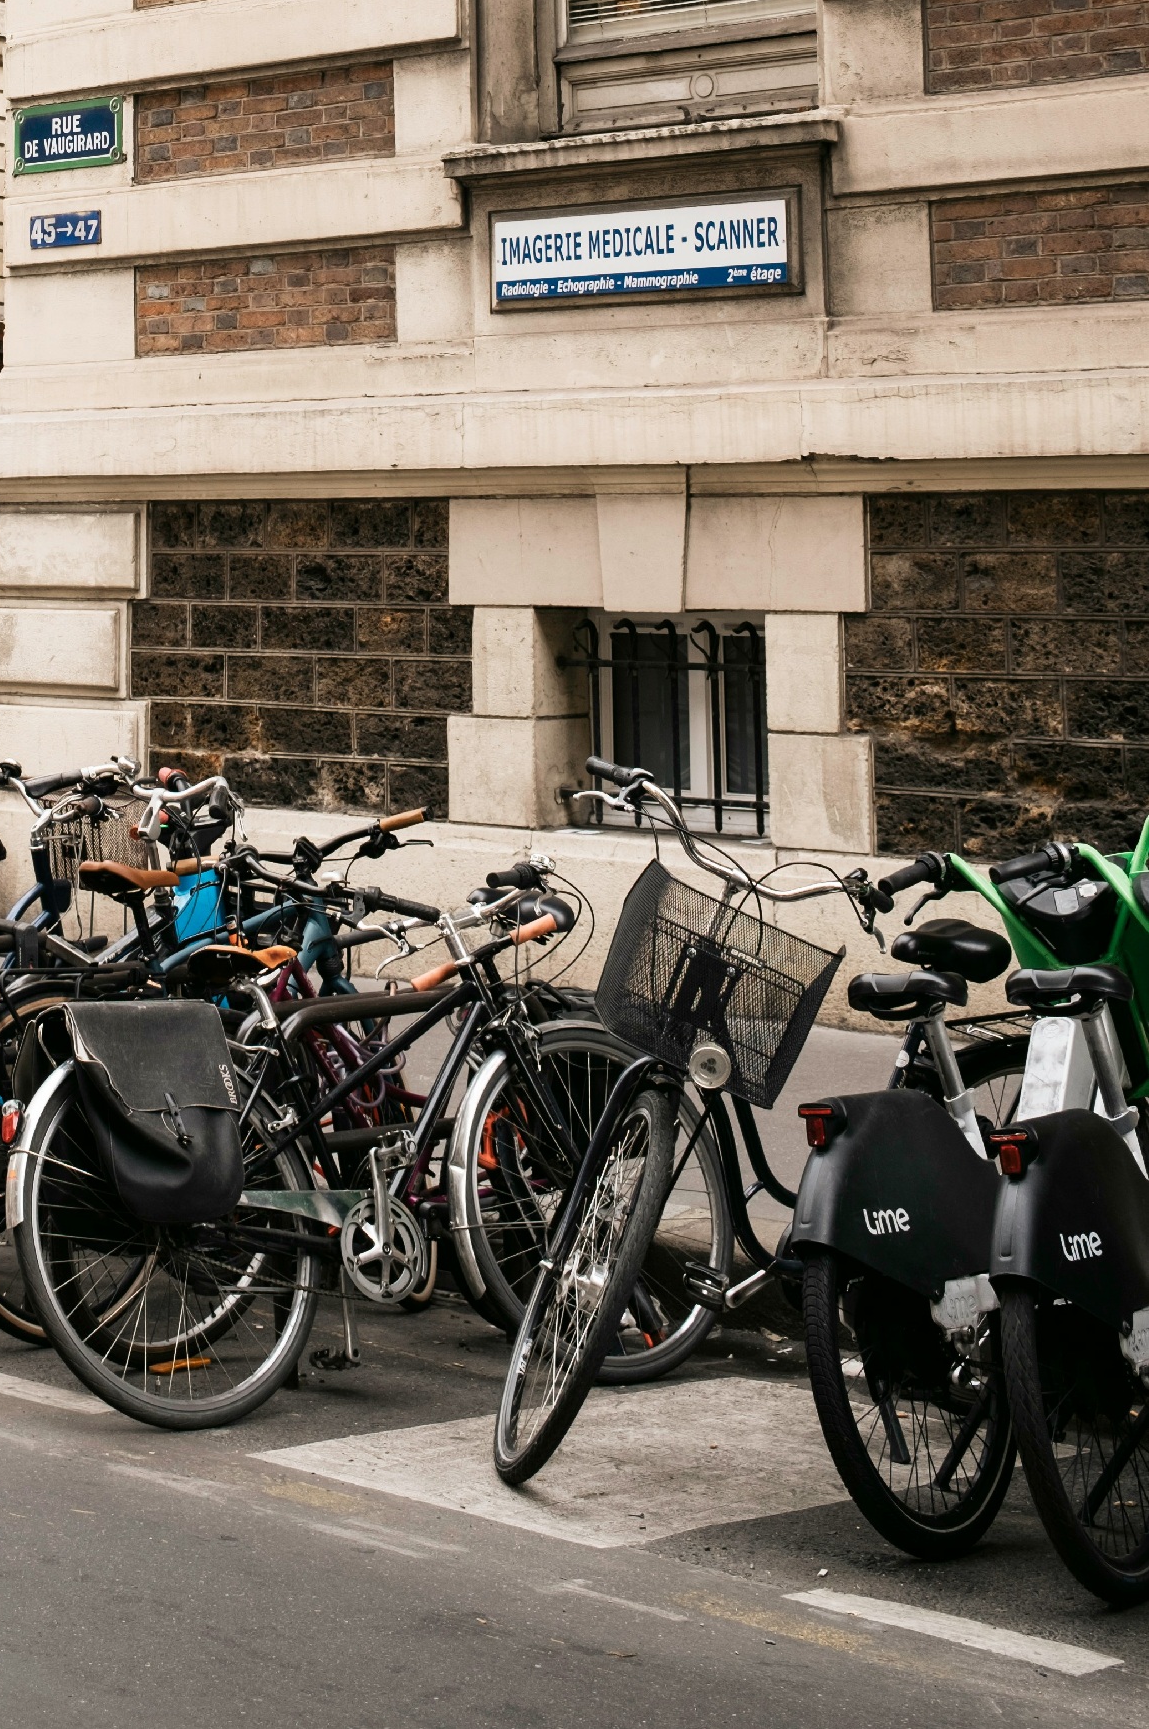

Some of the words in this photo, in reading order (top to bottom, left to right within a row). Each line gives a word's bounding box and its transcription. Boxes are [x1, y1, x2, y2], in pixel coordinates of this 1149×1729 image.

[51, 114, 82, 135] RUE
[24, 139, 39, 159] DE
[43, 131, 110, 156] VAUGIRARD
[30, 217, 56, 244] 45
[74, 219, 99, 241] 47
[500, 231, 582, 266] IMAGERIE
[588, 223, 675, 259] MEDICALE
[694, 216, 780, 253] SCANNER
[501, 281, 549, 297] Radiologie
[557, 276, 615, 294] Echographie
[623, 270, 699, 289] Mammographie
[750, 266, 782, 283] étage
[218, 1063, 238, 1105] BROOKS
[862, 1207, 911, 1235] Lime
[1059, 1231, 1103, 1262] Lime
